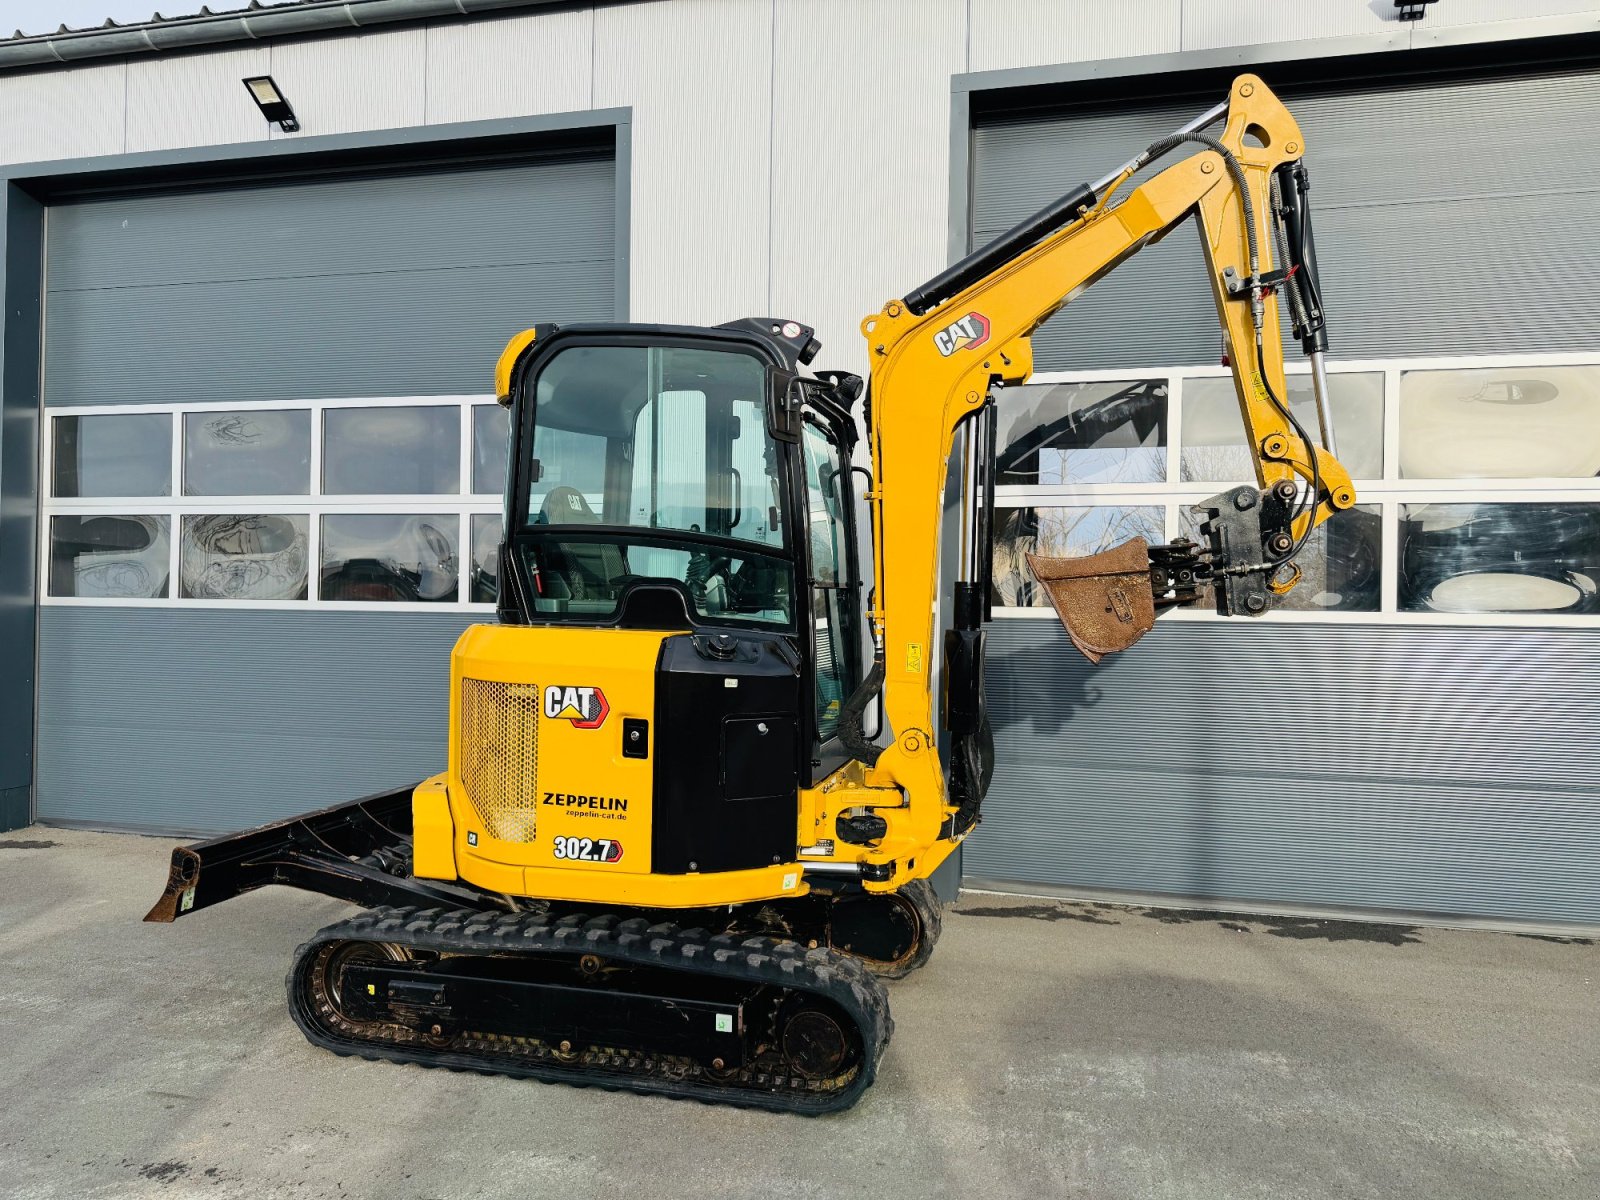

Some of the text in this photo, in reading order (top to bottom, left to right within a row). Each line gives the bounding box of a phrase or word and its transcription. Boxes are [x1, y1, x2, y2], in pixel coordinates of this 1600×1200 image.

[933, 314, 978, 357] CAT
[545, 685, 594, 719] CAT
[542, 792, 628, 811] ZEPPELIN
[565, 809, 627, 820] zeppelin-cat.de
[553, 835, 611, 861] 302.7
